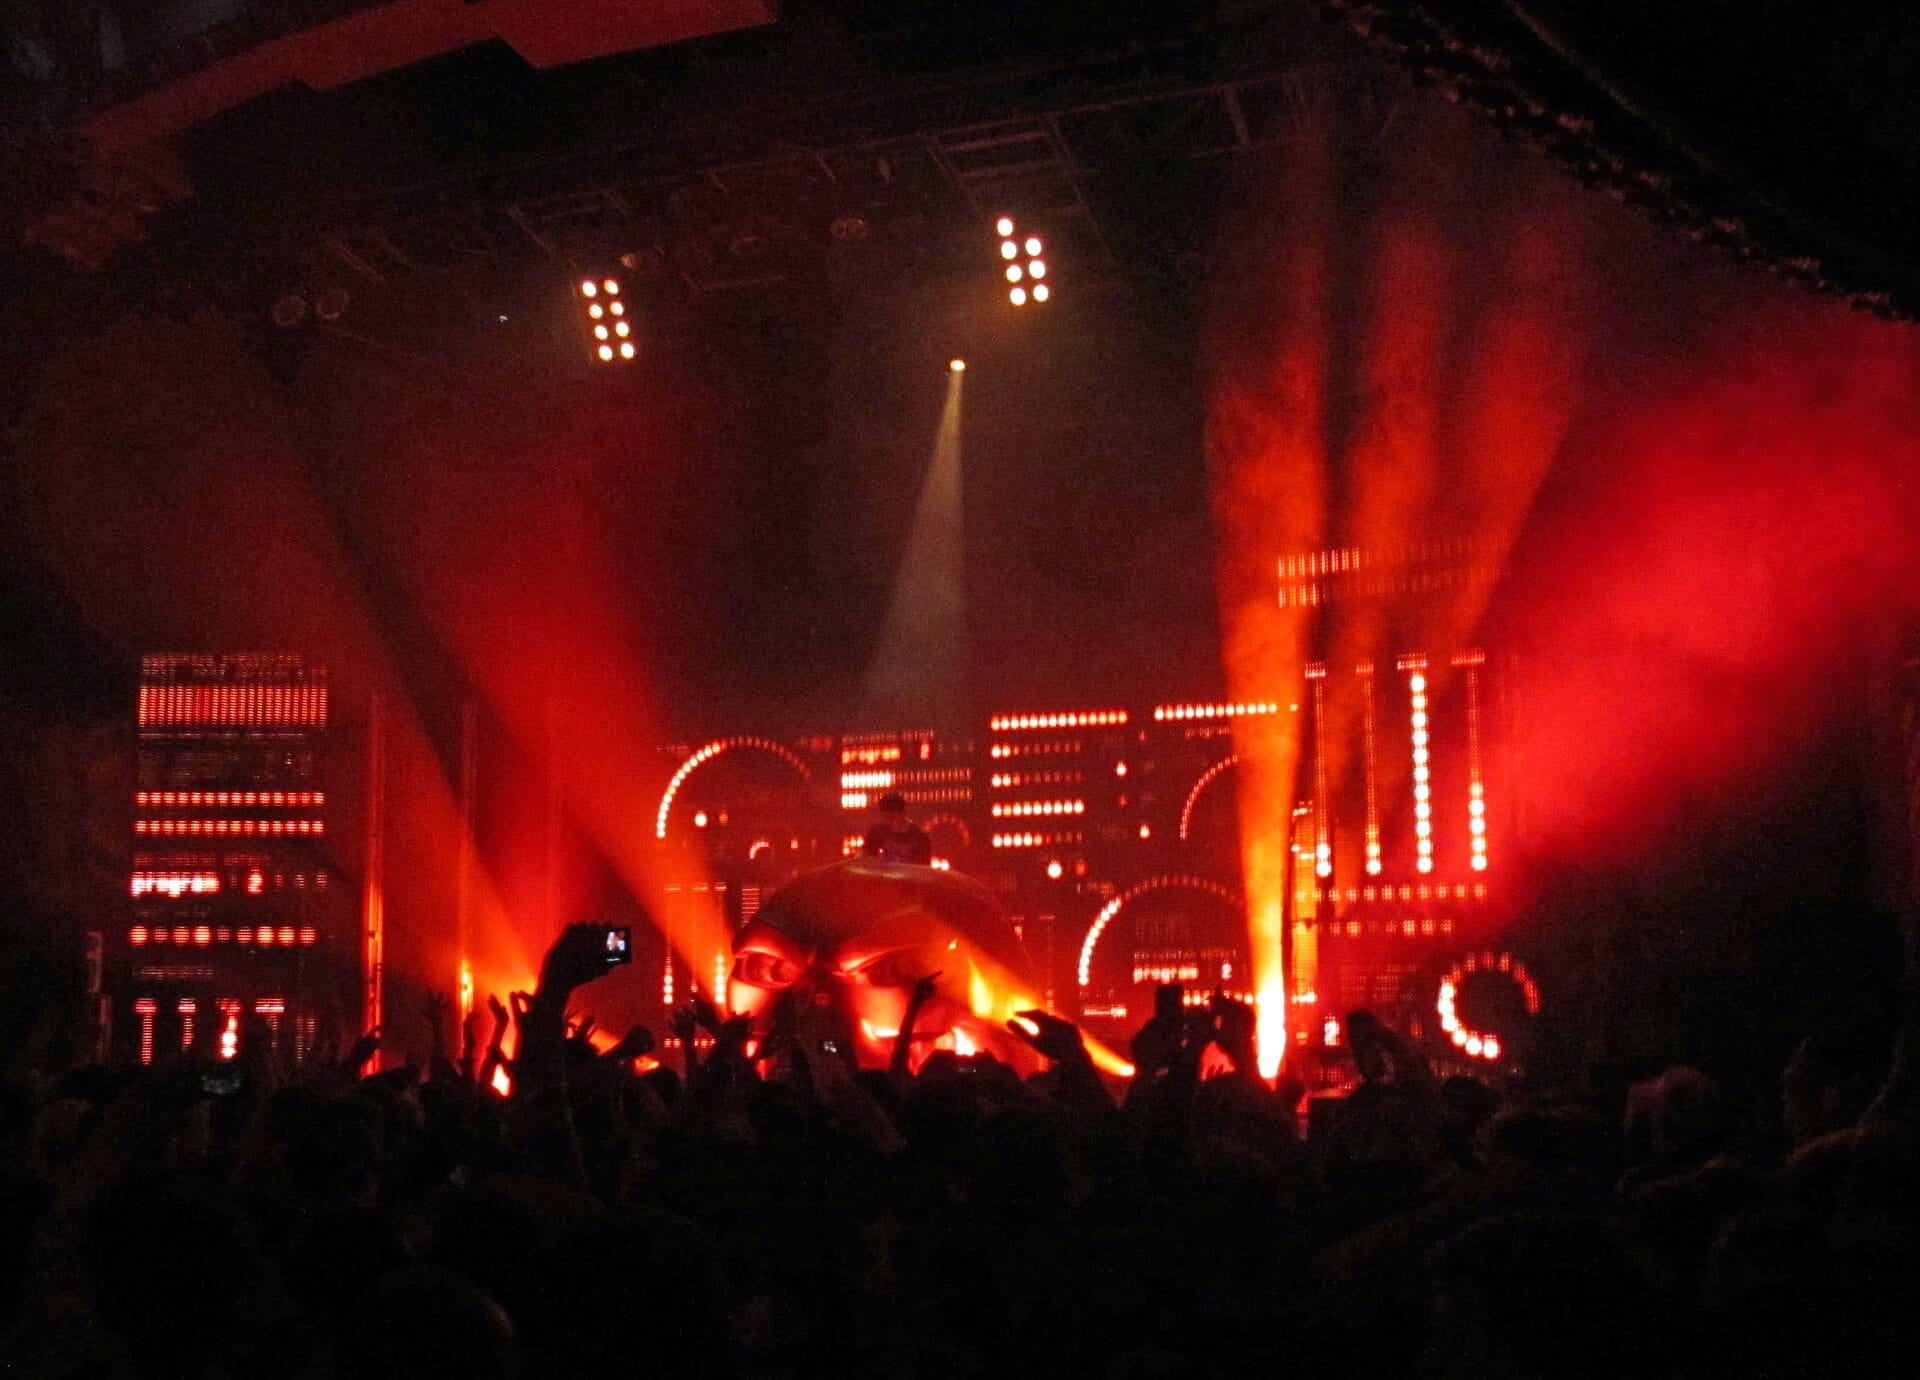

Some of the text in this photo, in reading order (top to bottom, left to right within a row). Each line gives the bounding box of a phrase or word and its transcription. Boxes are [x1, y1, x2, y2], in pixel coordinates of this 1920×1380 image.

[131, 871, 220, 899] program
[1133, 961, 1232, 984] program 2
